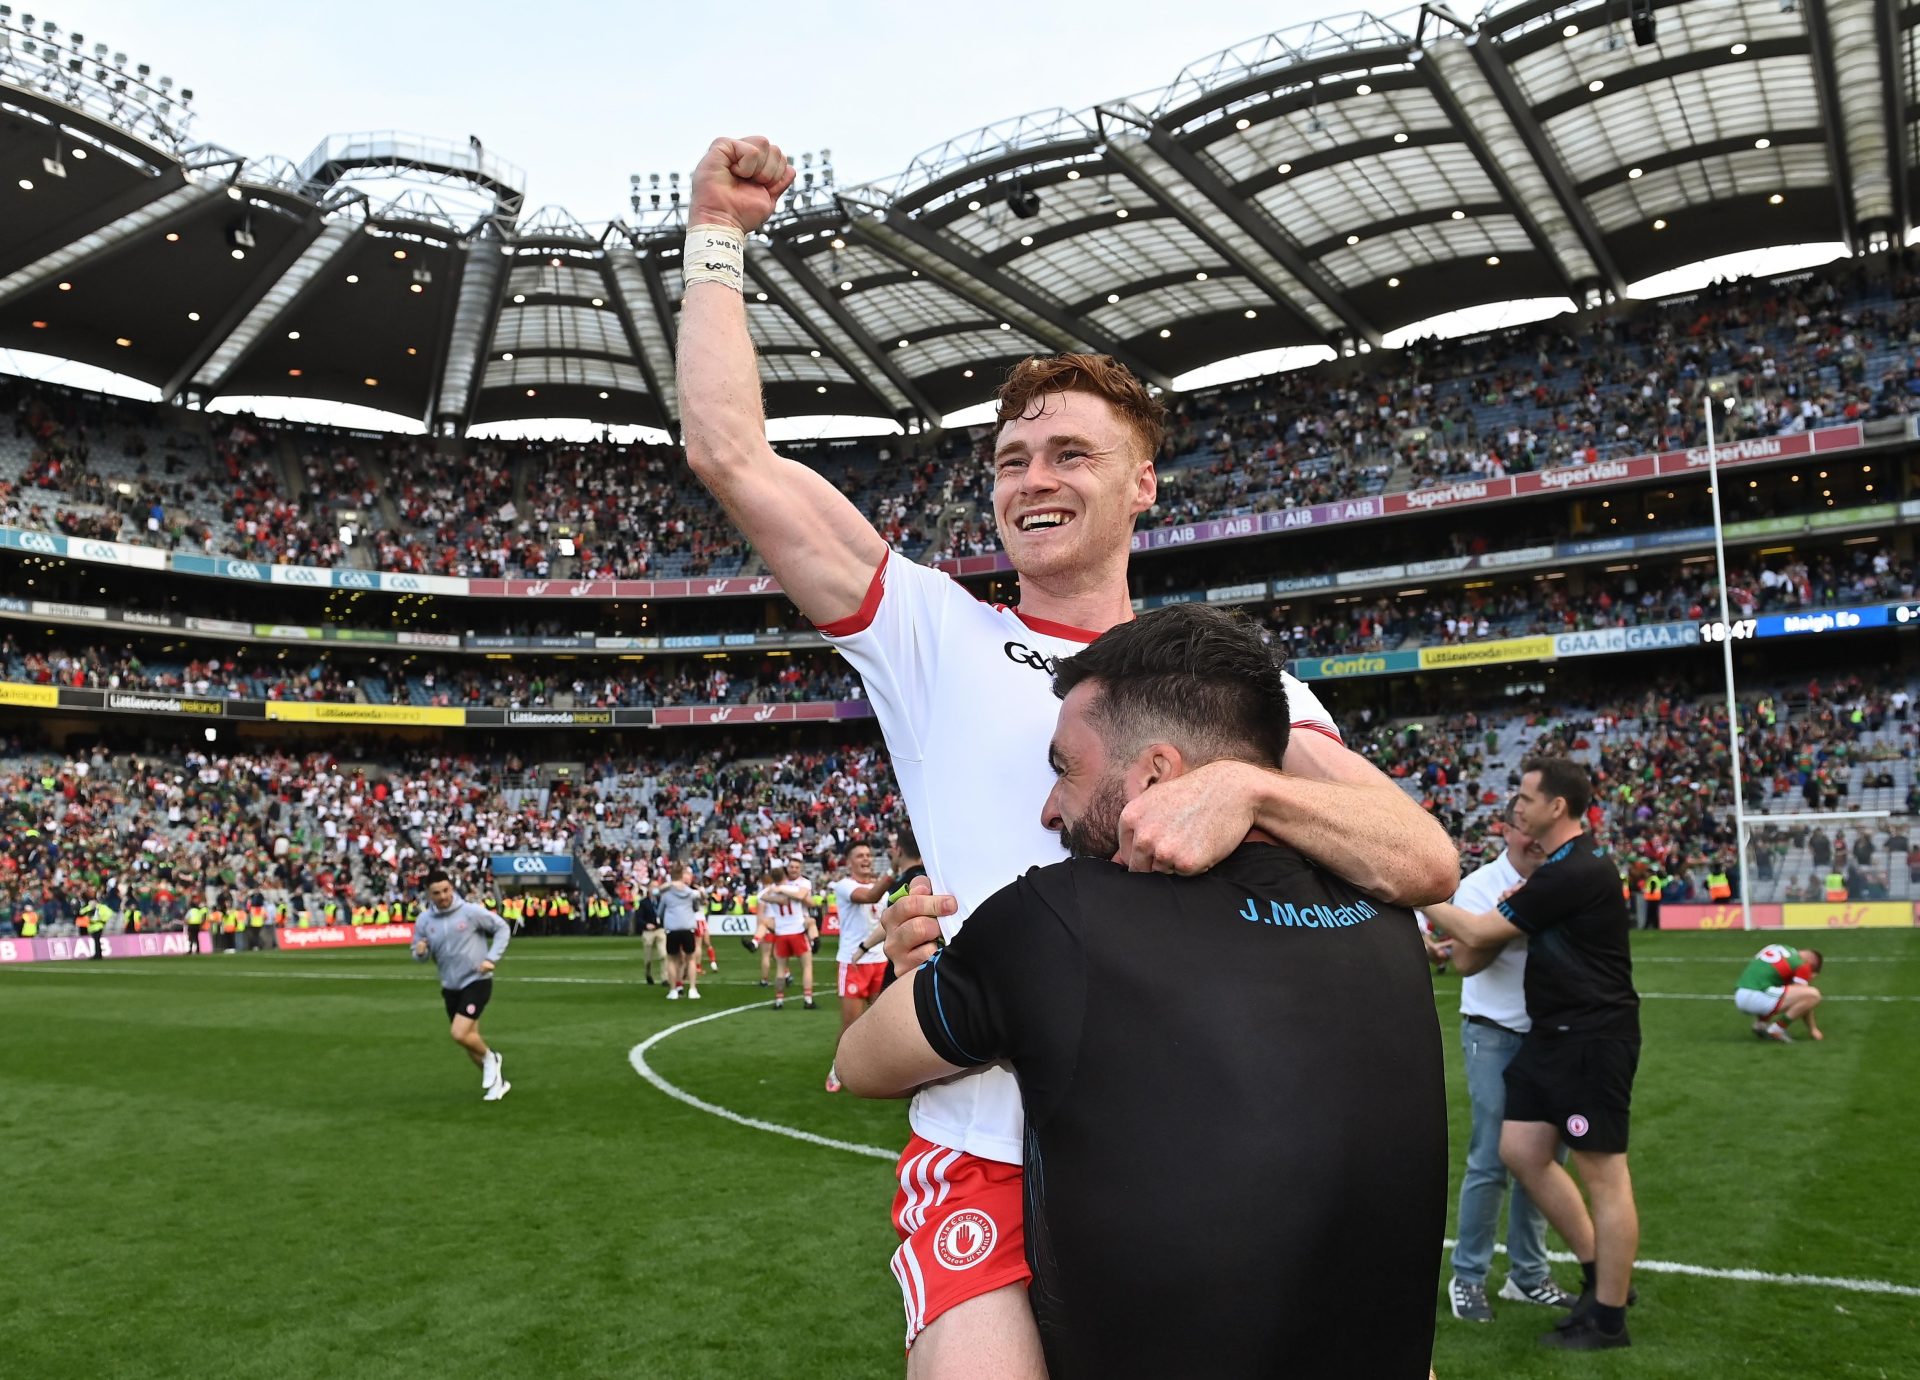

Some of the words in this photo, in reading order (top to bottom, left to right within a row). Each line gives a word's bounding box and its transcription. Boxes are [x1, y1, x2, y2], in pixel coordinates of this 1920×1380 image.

[1541, 462, 1629, 489] SuperValu
[1406, 483, 1487, 509] SuperValu
[1284, 510, 1313, 526] AIB
[1345, 501, 1374, 518] AIB
[1169, 528, 1196, 543] AIB
[1225, 519, 1251, 535] AIB
[1557, 634, 1623, 652] GAA.ie
[1625, 626, 1697, 647] GAA.ie
[1321, 658, 1386, 676] Centra
